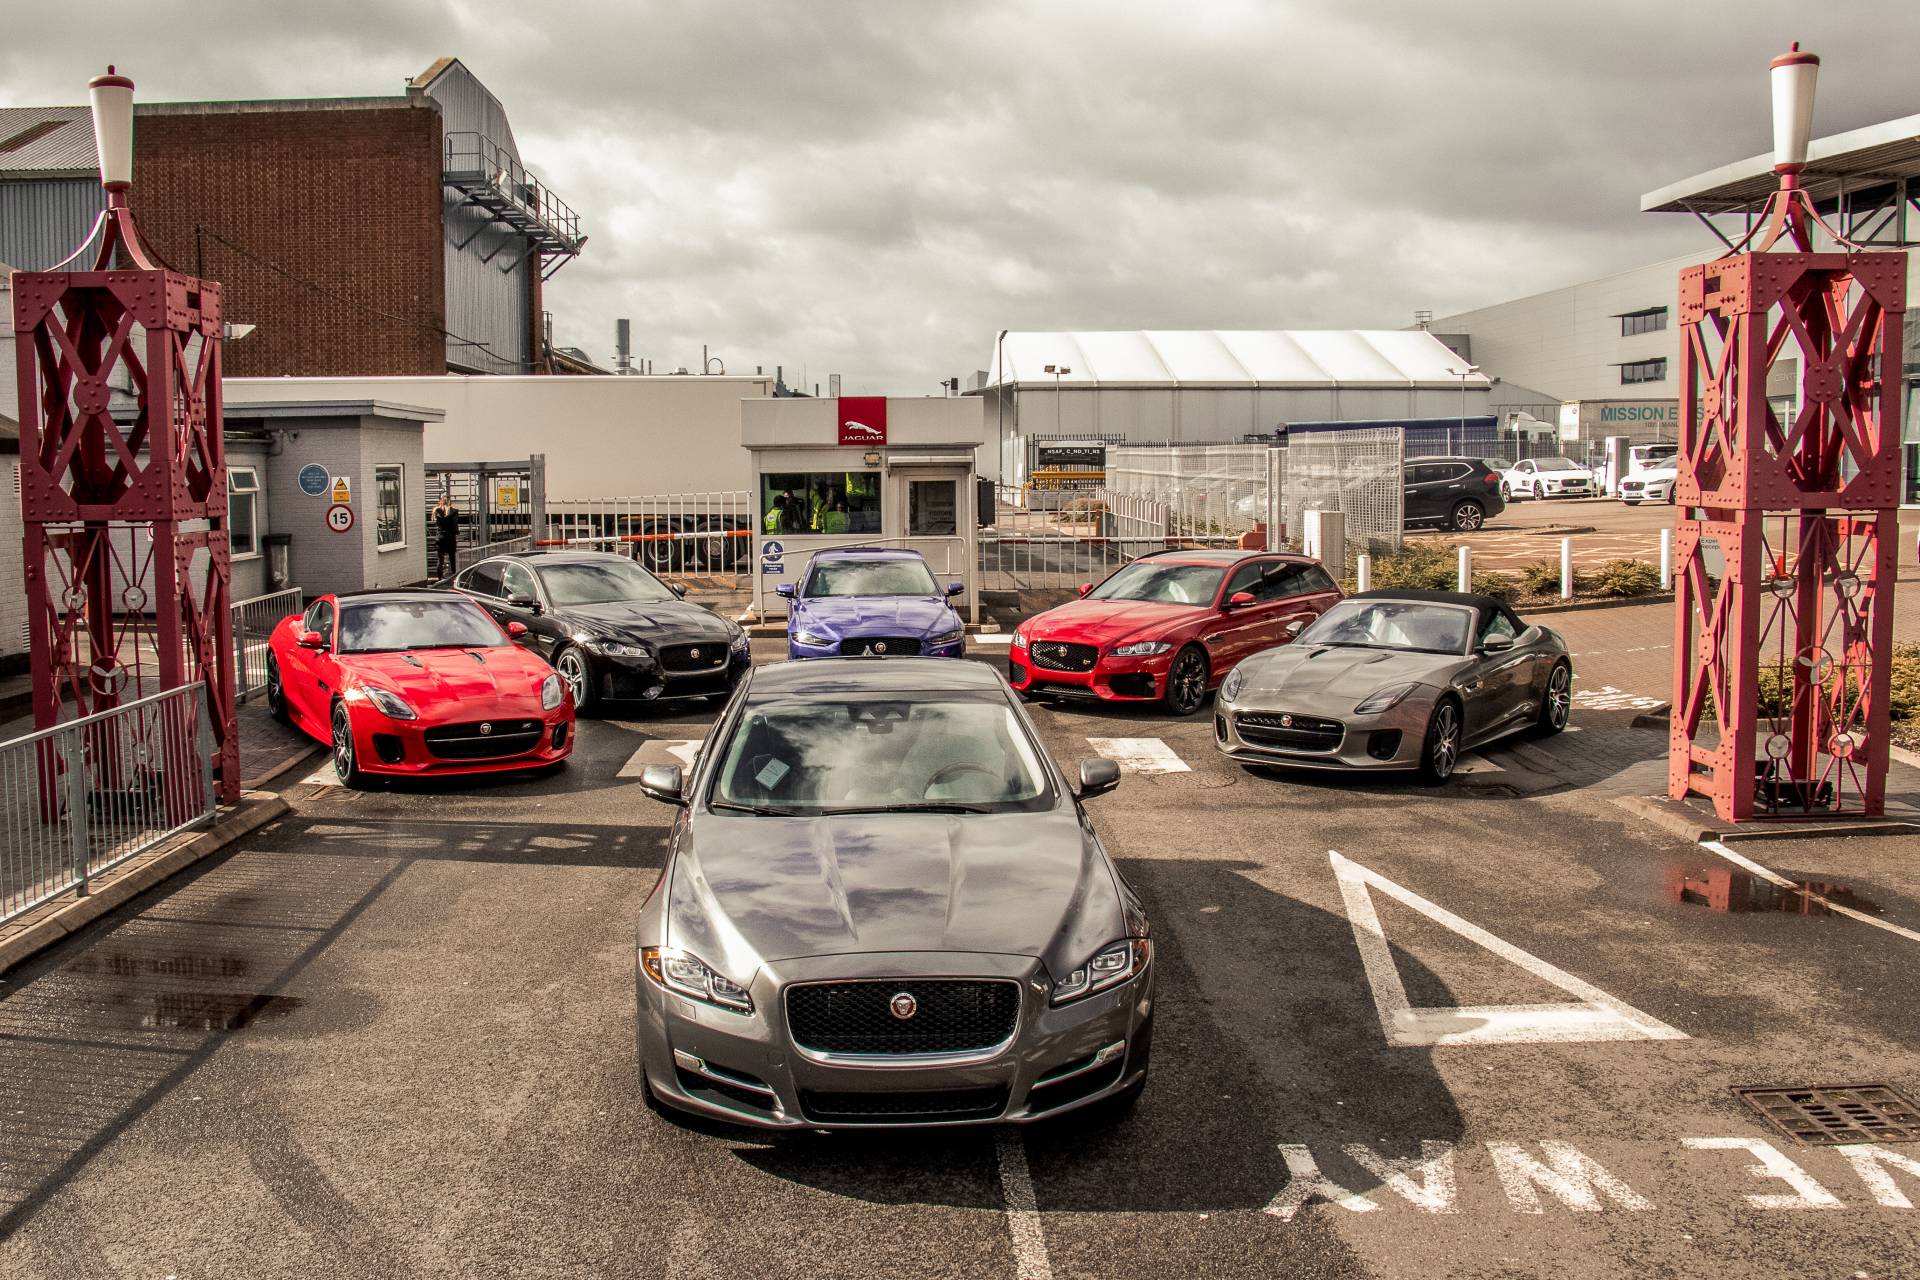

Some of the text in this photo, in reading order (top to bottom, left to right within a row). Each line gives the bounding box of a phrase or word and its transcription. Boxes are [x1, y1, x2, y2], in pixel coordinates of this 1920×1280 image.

[1600, 407, 1664, 421] MISSION
[333, 513, 348, 525] 15
[1262, 1137, 1920, 1223] VE WAY
